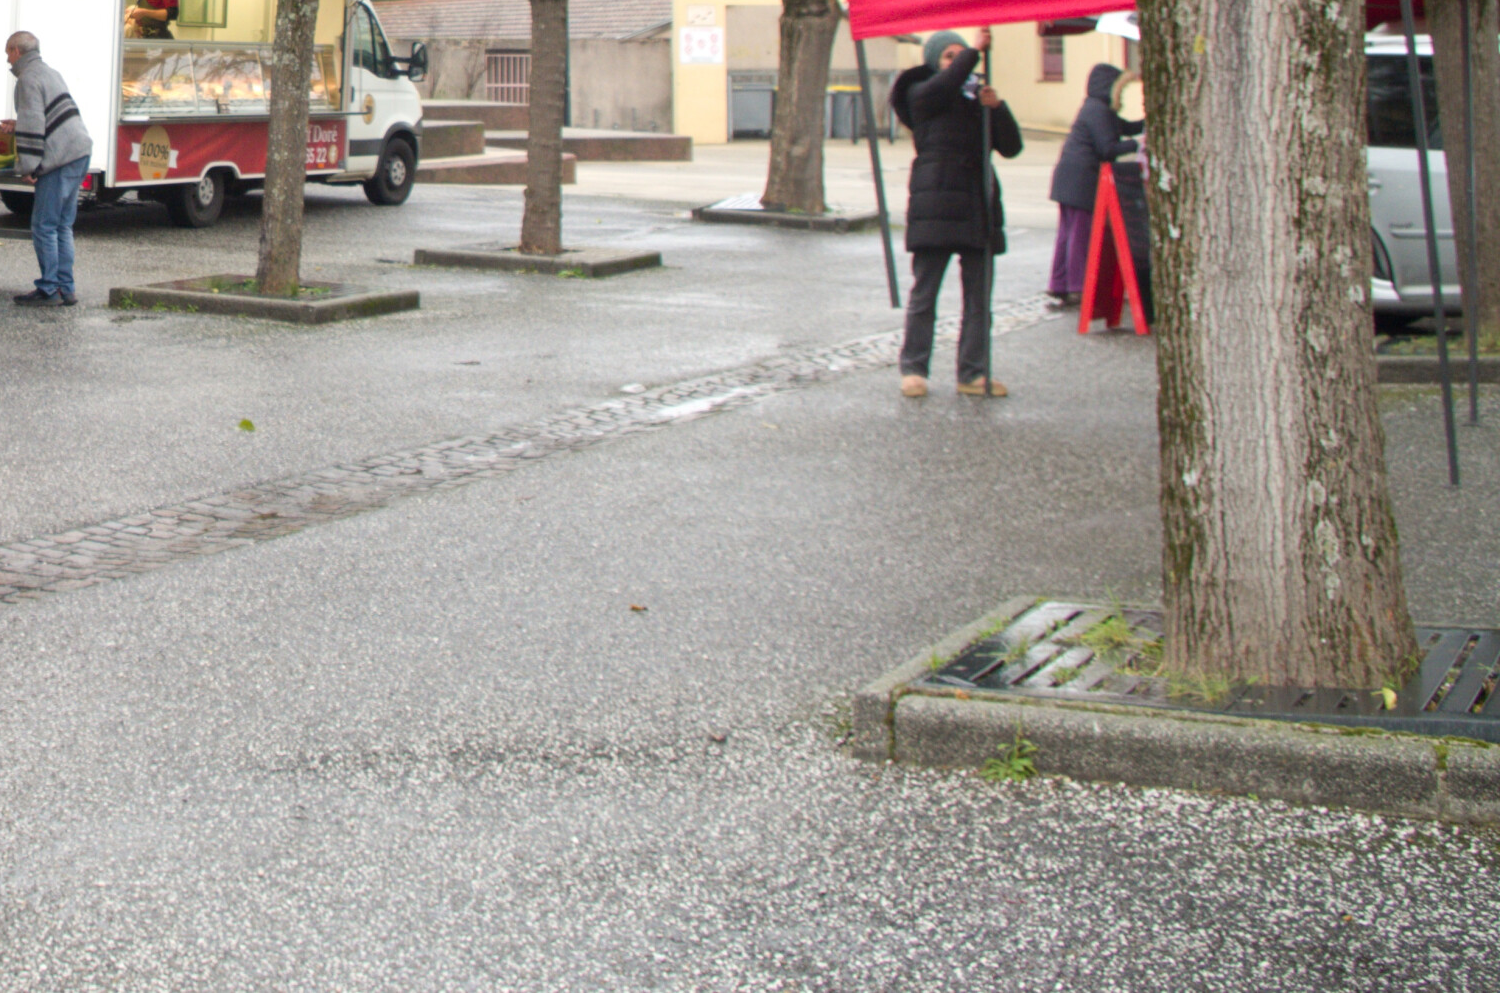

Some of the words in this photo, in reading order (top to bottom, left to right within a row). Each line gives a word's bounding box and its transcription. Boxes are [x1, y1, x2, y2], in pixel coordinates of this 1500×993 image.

[312, 124, 338, 143] Doré
[141, 142, 169, 160] 100%
[316, 147, 327, 163] 22
